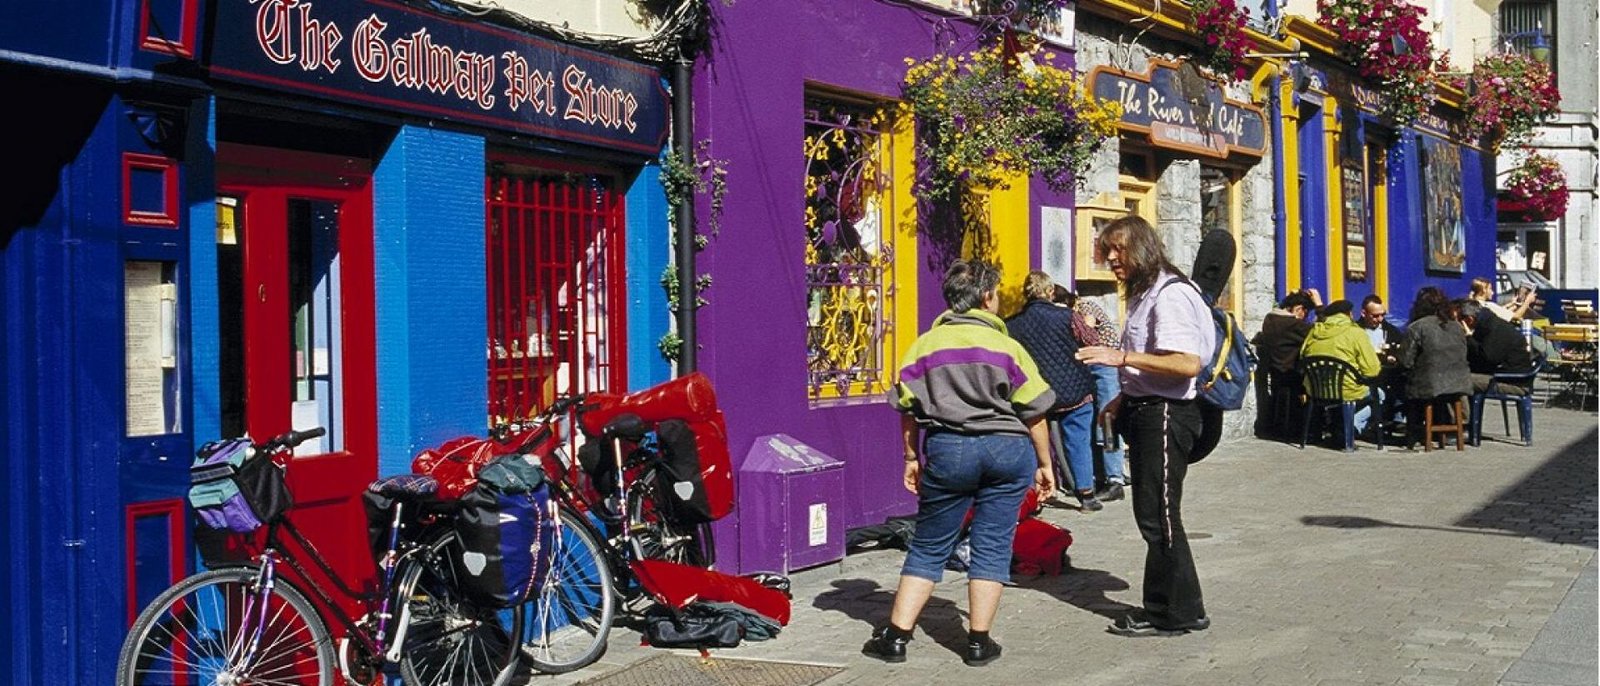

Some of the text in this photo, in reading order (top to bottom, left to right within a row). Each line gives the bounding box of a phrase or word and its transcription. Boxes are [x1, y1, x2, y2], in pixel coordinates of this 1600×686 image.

[248, 0, 638, 134] The Galway Pet Store
[1118, 81, 1142, 114] The
[1148, 87, 1184, 123] River
[1219, 106, 1244, 146] Café
